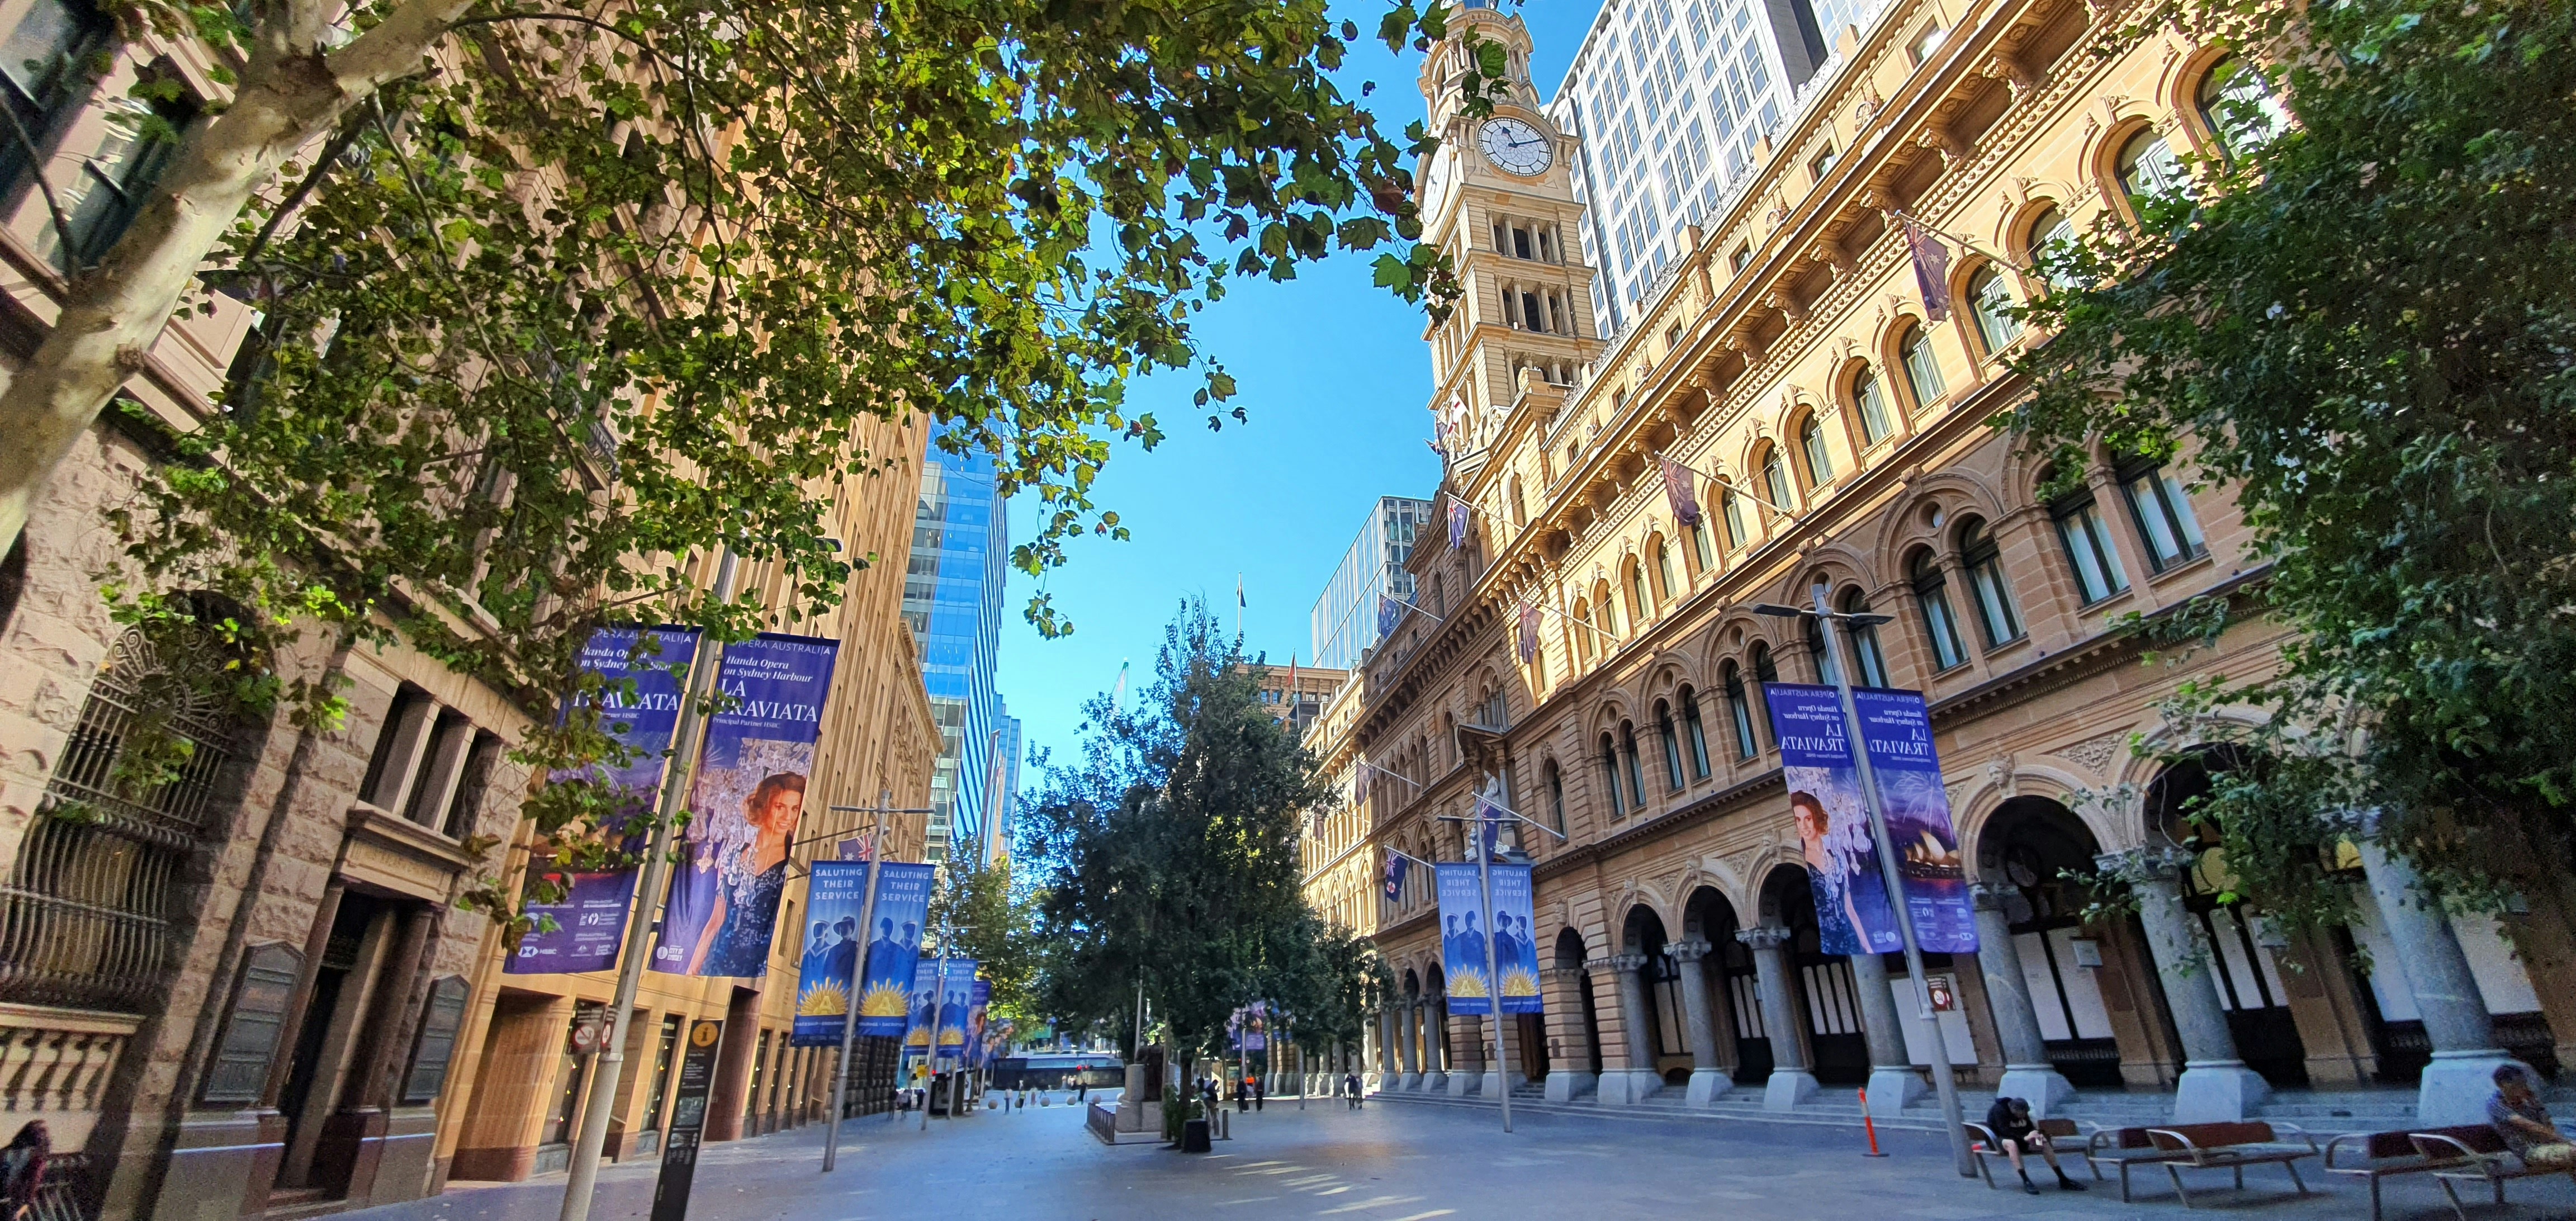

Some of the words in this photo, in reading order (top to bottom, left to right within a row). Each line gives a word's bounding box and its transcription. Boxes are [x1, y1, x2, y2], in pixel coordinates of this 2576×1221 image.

[594, 659, 628, 671] Sydney
[726, 655, 758, 666] Handa
[760, 659, 789, 669] Opera
[737, 668, 771, 680] Sydney
[773, 671, 813, 683] Harbour
[722, 679, 746, 697] LA
[713, 717, 739, 725] Principal
[884, 870, 929, 879] SALUTING
[823, 879, 854, 888] THEIR
[891, 882, 921, 890] THEIR
[815, 891, 859, 900] SERVICE
[881, 893, 925, 902] SERVICE
